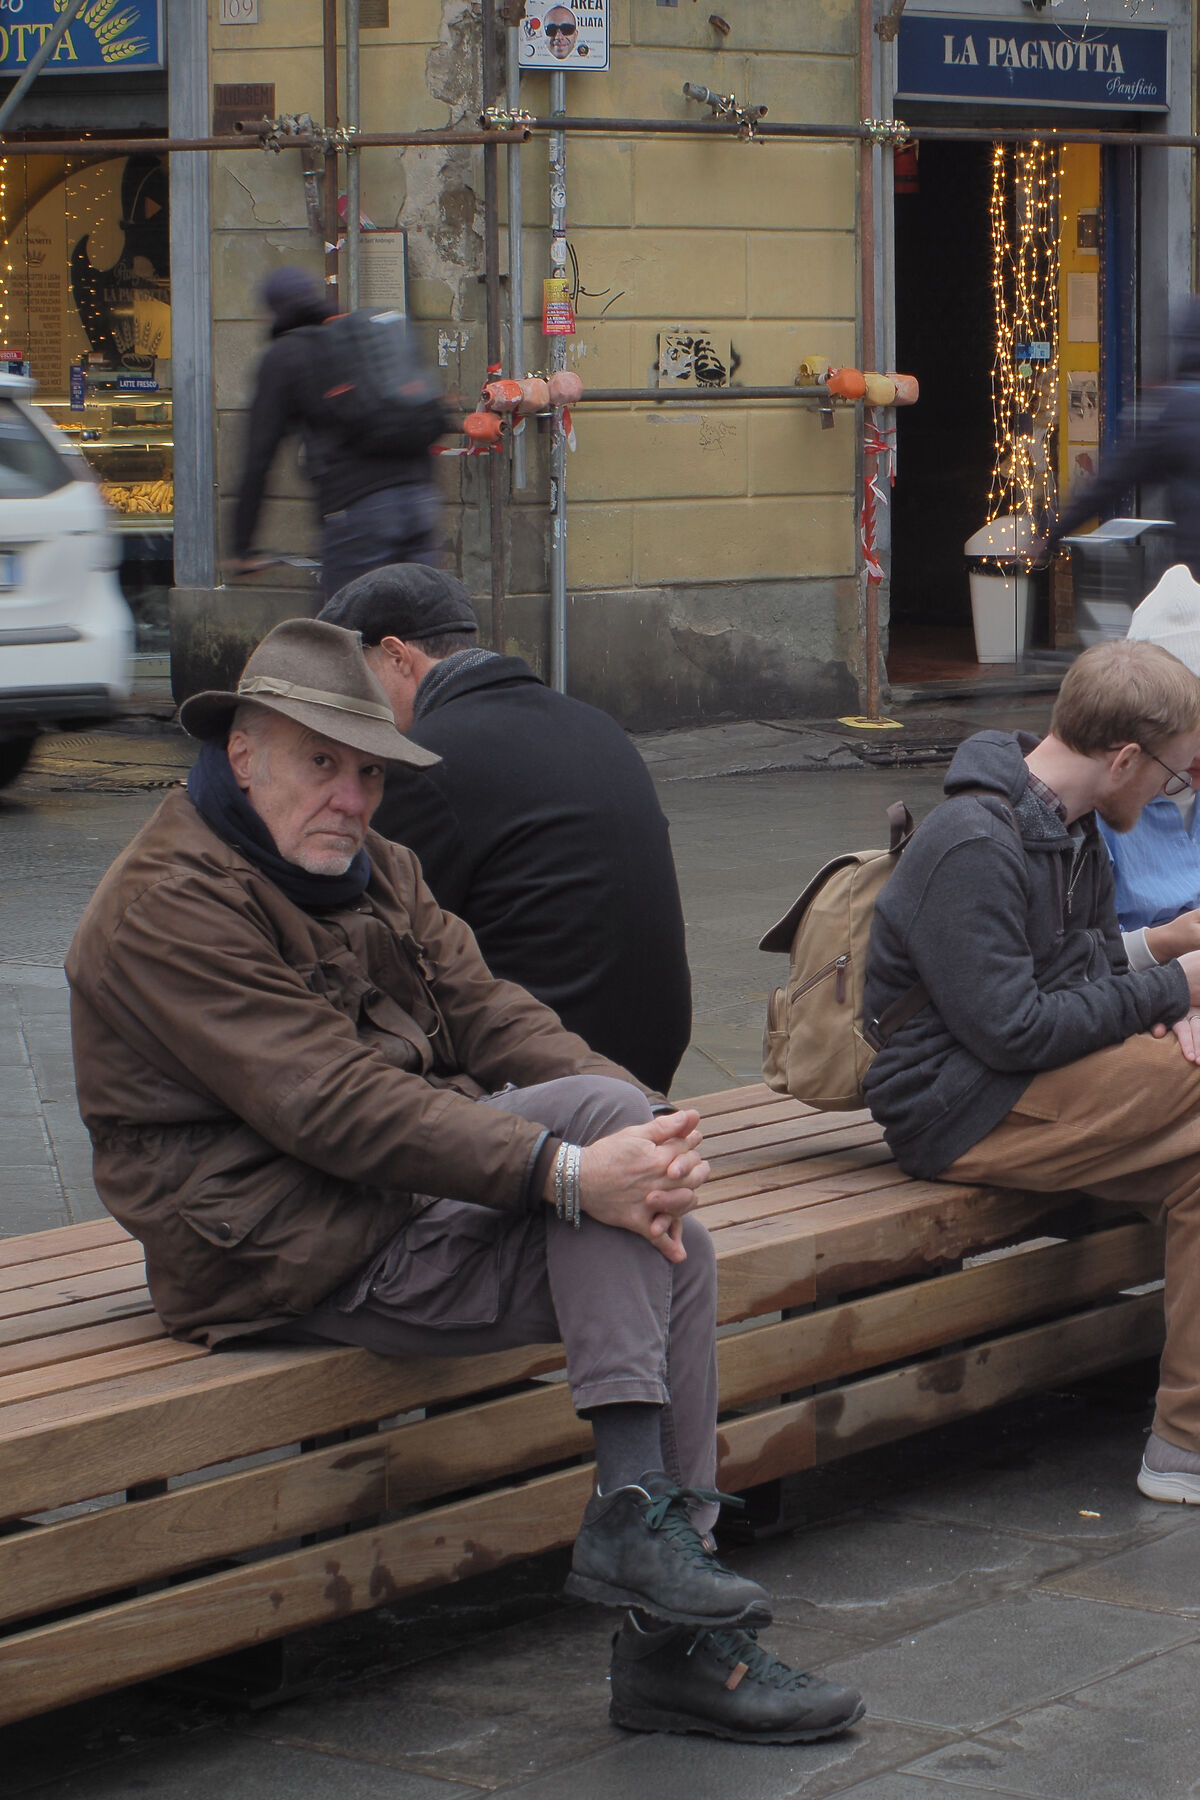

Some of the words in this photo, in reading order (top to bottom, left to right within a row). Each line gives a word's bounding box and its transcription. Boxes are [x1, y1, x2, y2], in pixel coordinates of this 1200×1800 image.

[570, 0, 604, 10] AREA
[943, 34, 980, 66] LA
[988, 37, 1126, 74] PAGNOTTA
[1105, 76, 1158, 101] Panificio
[119, 380, 135, 388] LATTE
[136, 380, 158, 388] FRESCO
